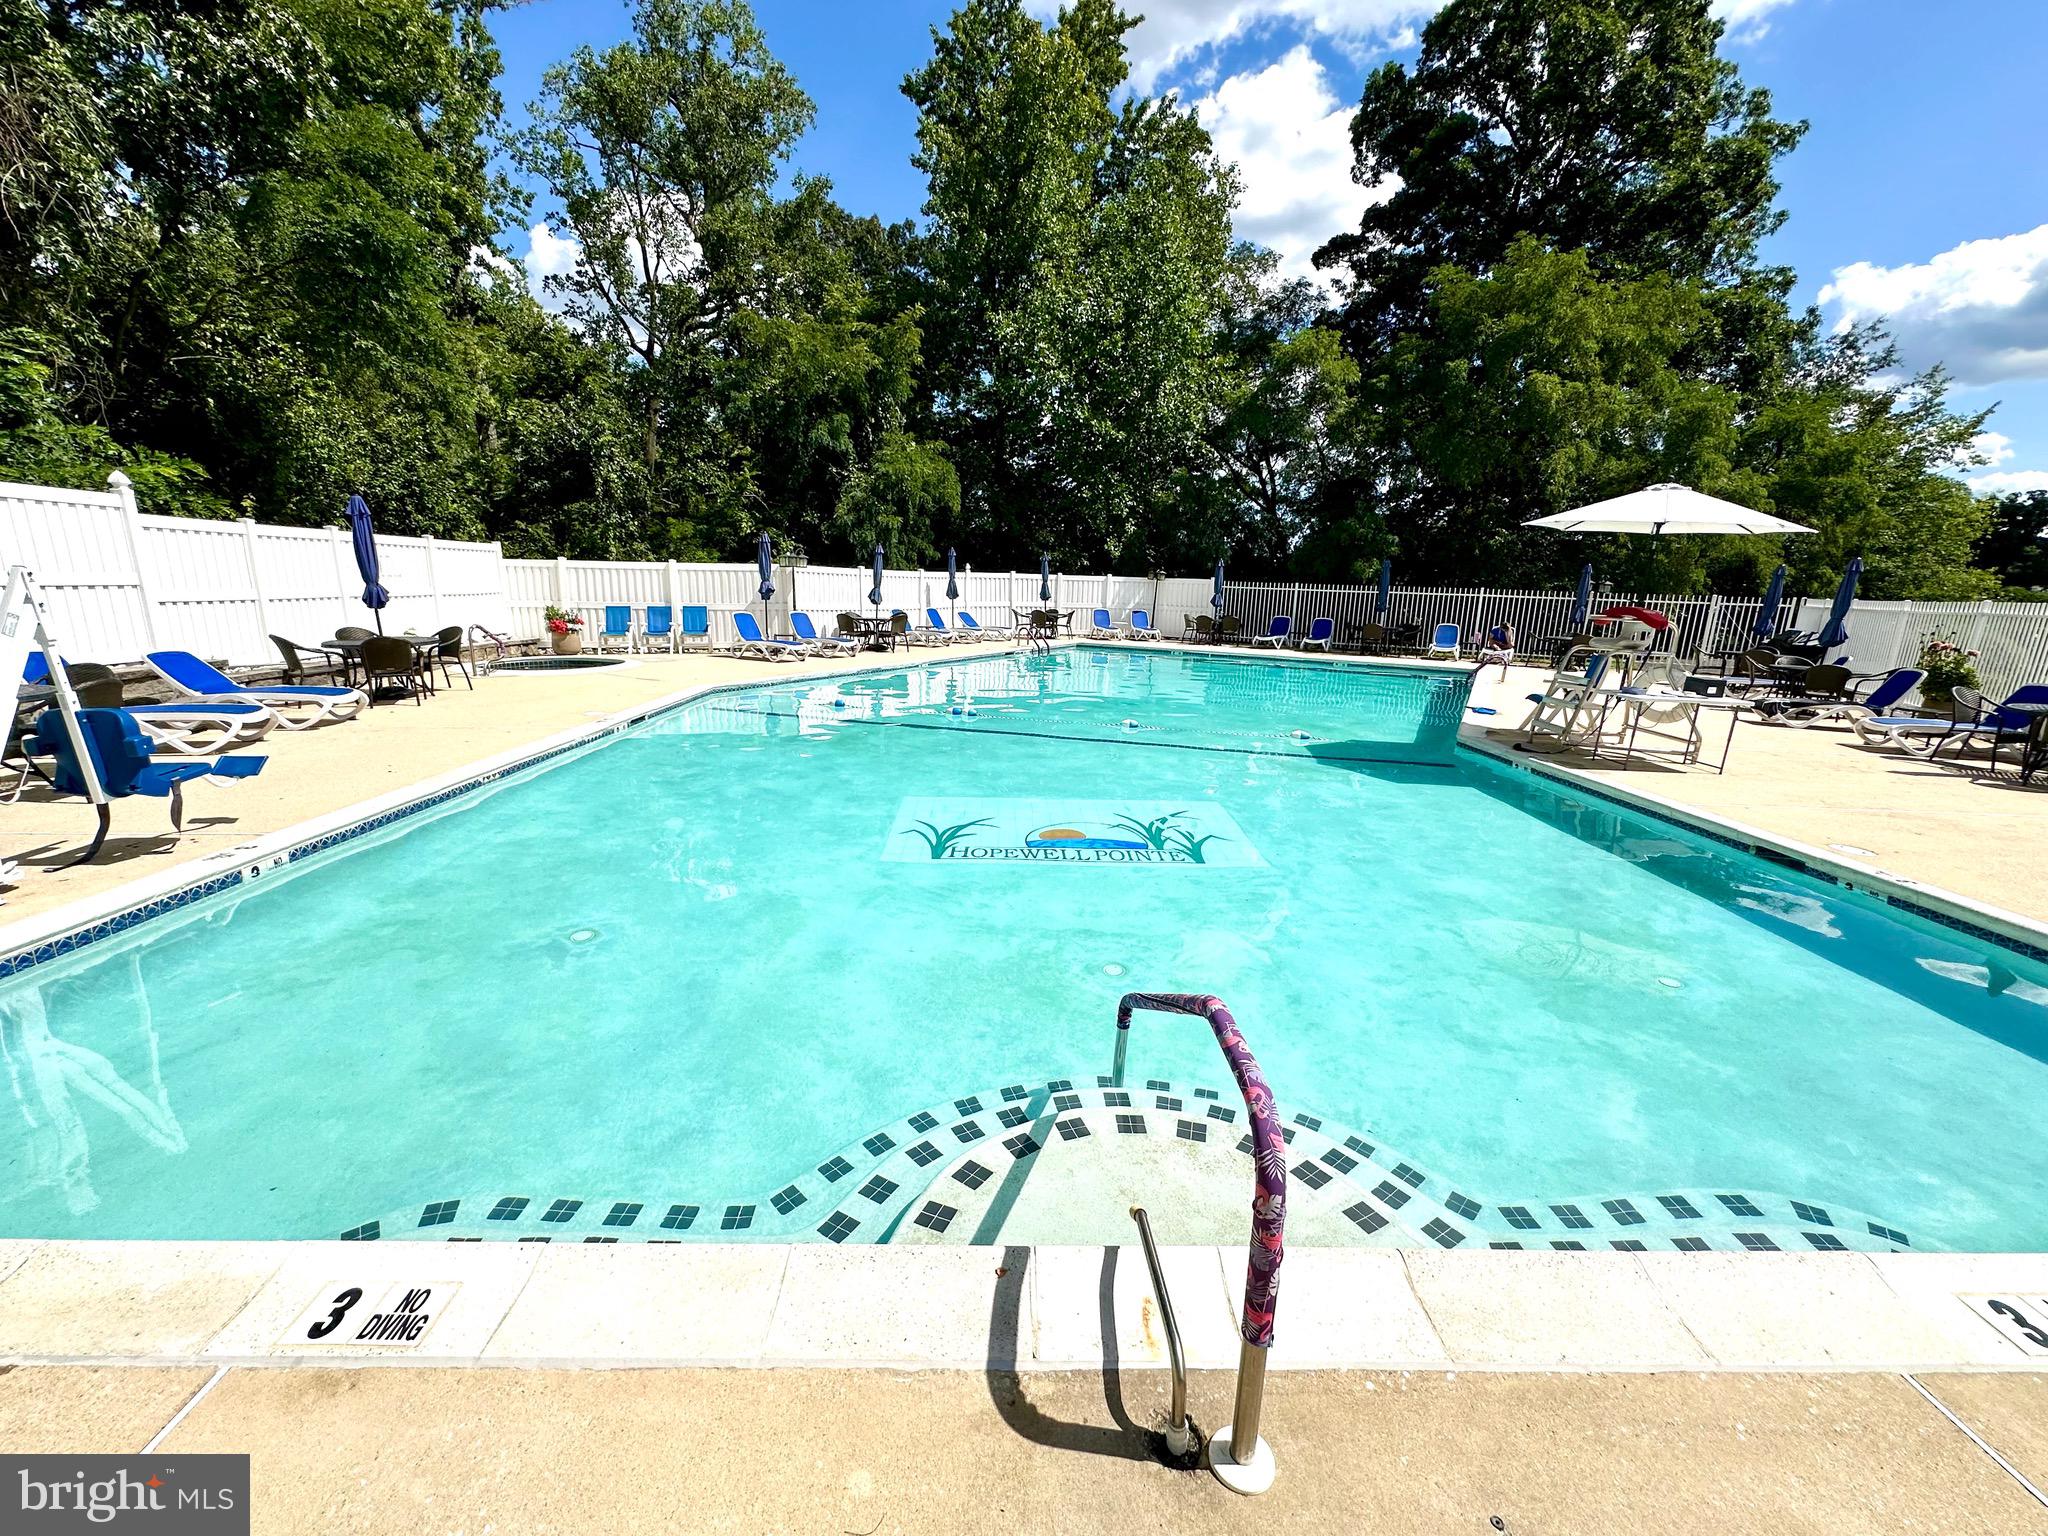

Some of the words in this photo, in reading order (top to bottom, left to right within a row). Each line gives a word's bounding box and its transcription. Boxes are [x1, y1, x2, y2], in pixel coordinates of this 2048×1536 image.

[948, 846, 1090, 861] HOPEWELL
[1095, 850, 1186, 862] POINTE
[307, 1287, 363, 1340] 3
[394, 1288, 431, 1313] NO
[356, 1314, 430, 1341] DIVING
